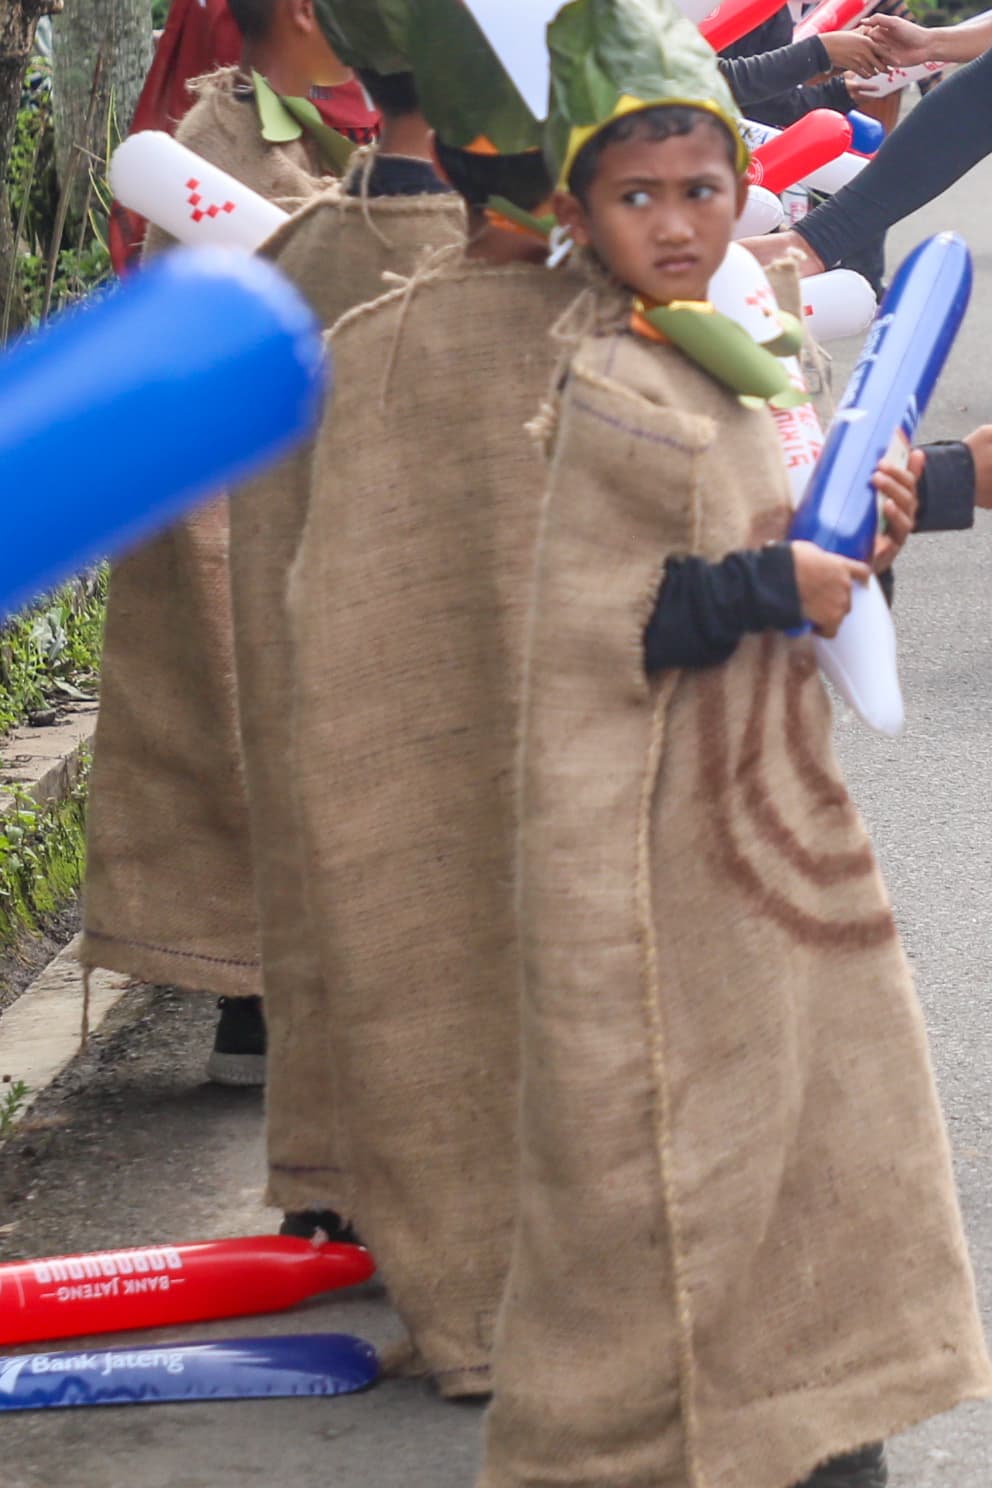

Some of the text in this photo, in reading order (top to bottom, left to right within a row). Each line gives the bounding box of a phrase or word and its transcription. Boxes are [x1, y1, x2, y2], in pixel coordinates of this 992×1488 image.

[56, 1275, 170, 1302] BANK JATENG
[32, 1352, 184, 1375] Bank Jateng
